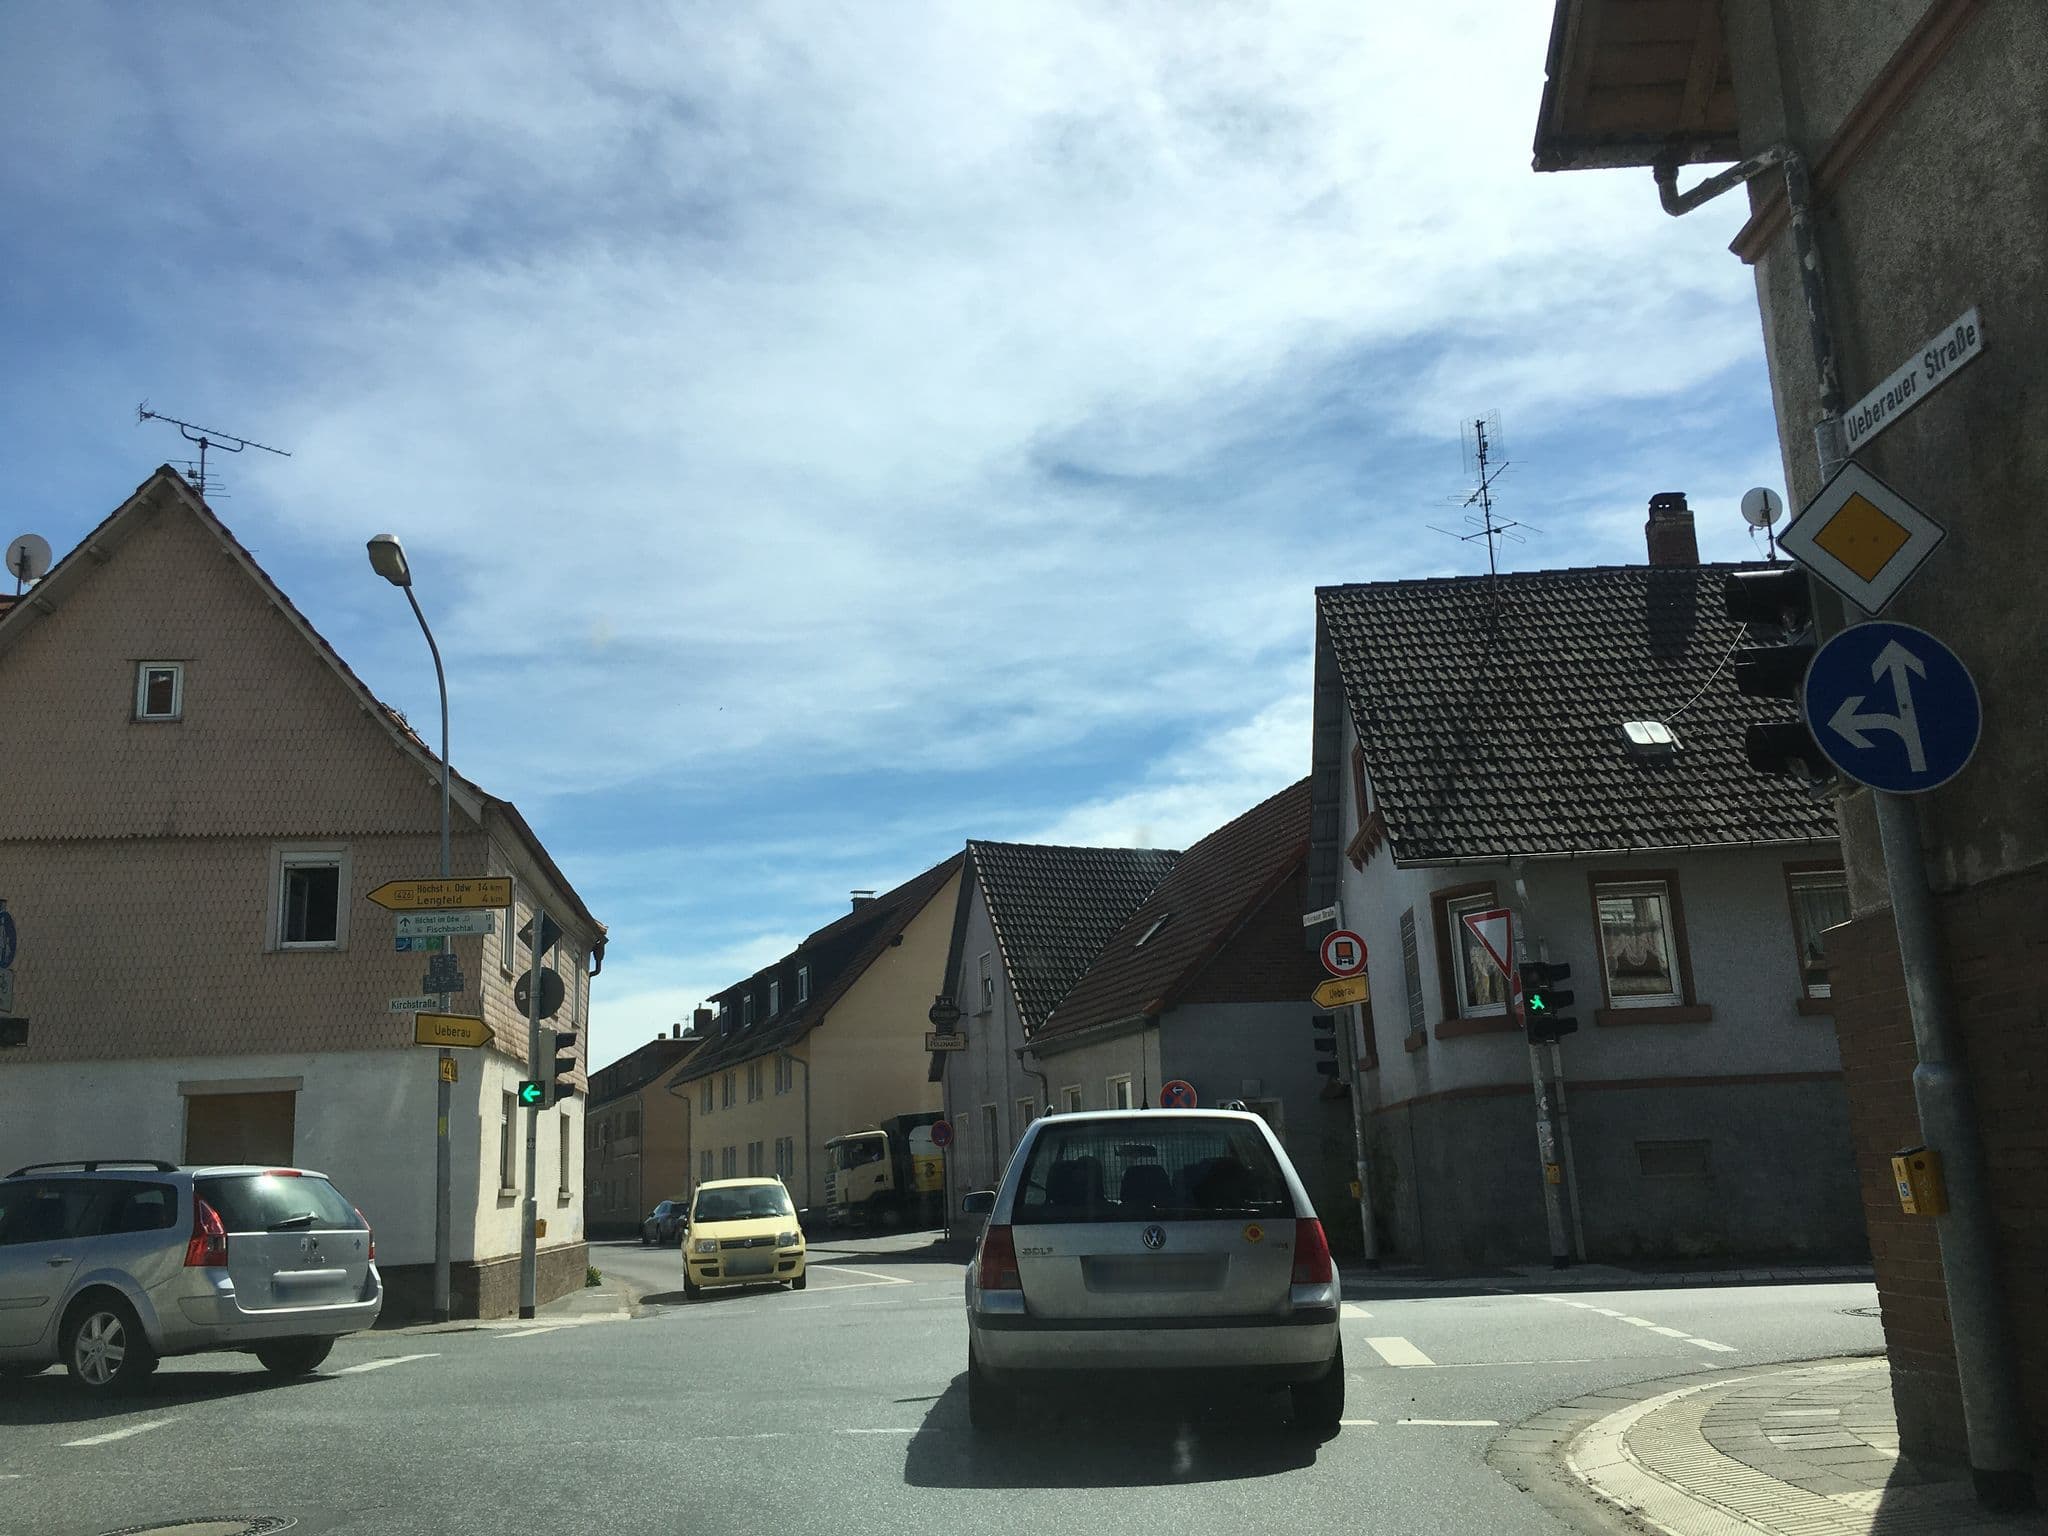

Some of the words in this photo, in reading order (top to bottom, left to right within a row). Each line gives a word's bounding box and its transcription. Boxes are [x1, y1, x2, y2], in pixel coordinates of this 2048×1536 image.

[1848, 372, 1917, 442] Ueberauer
[1924, 324, 1977, 379] Straße
[478, 883, 488, 892] 14
[490, 883, 503, 892] km
[396, 890, 411, 899] 426
[416, 895, 463, 906] Lengfeld
[482, 895, 488, 903] 4
[490, 894, 503, 903] km
[426, 924, 474, 934] Fischbachtal
[391, 998, 436, 1010] Kirchstraße
[434, 1023, 471, 1038] Ueberau
